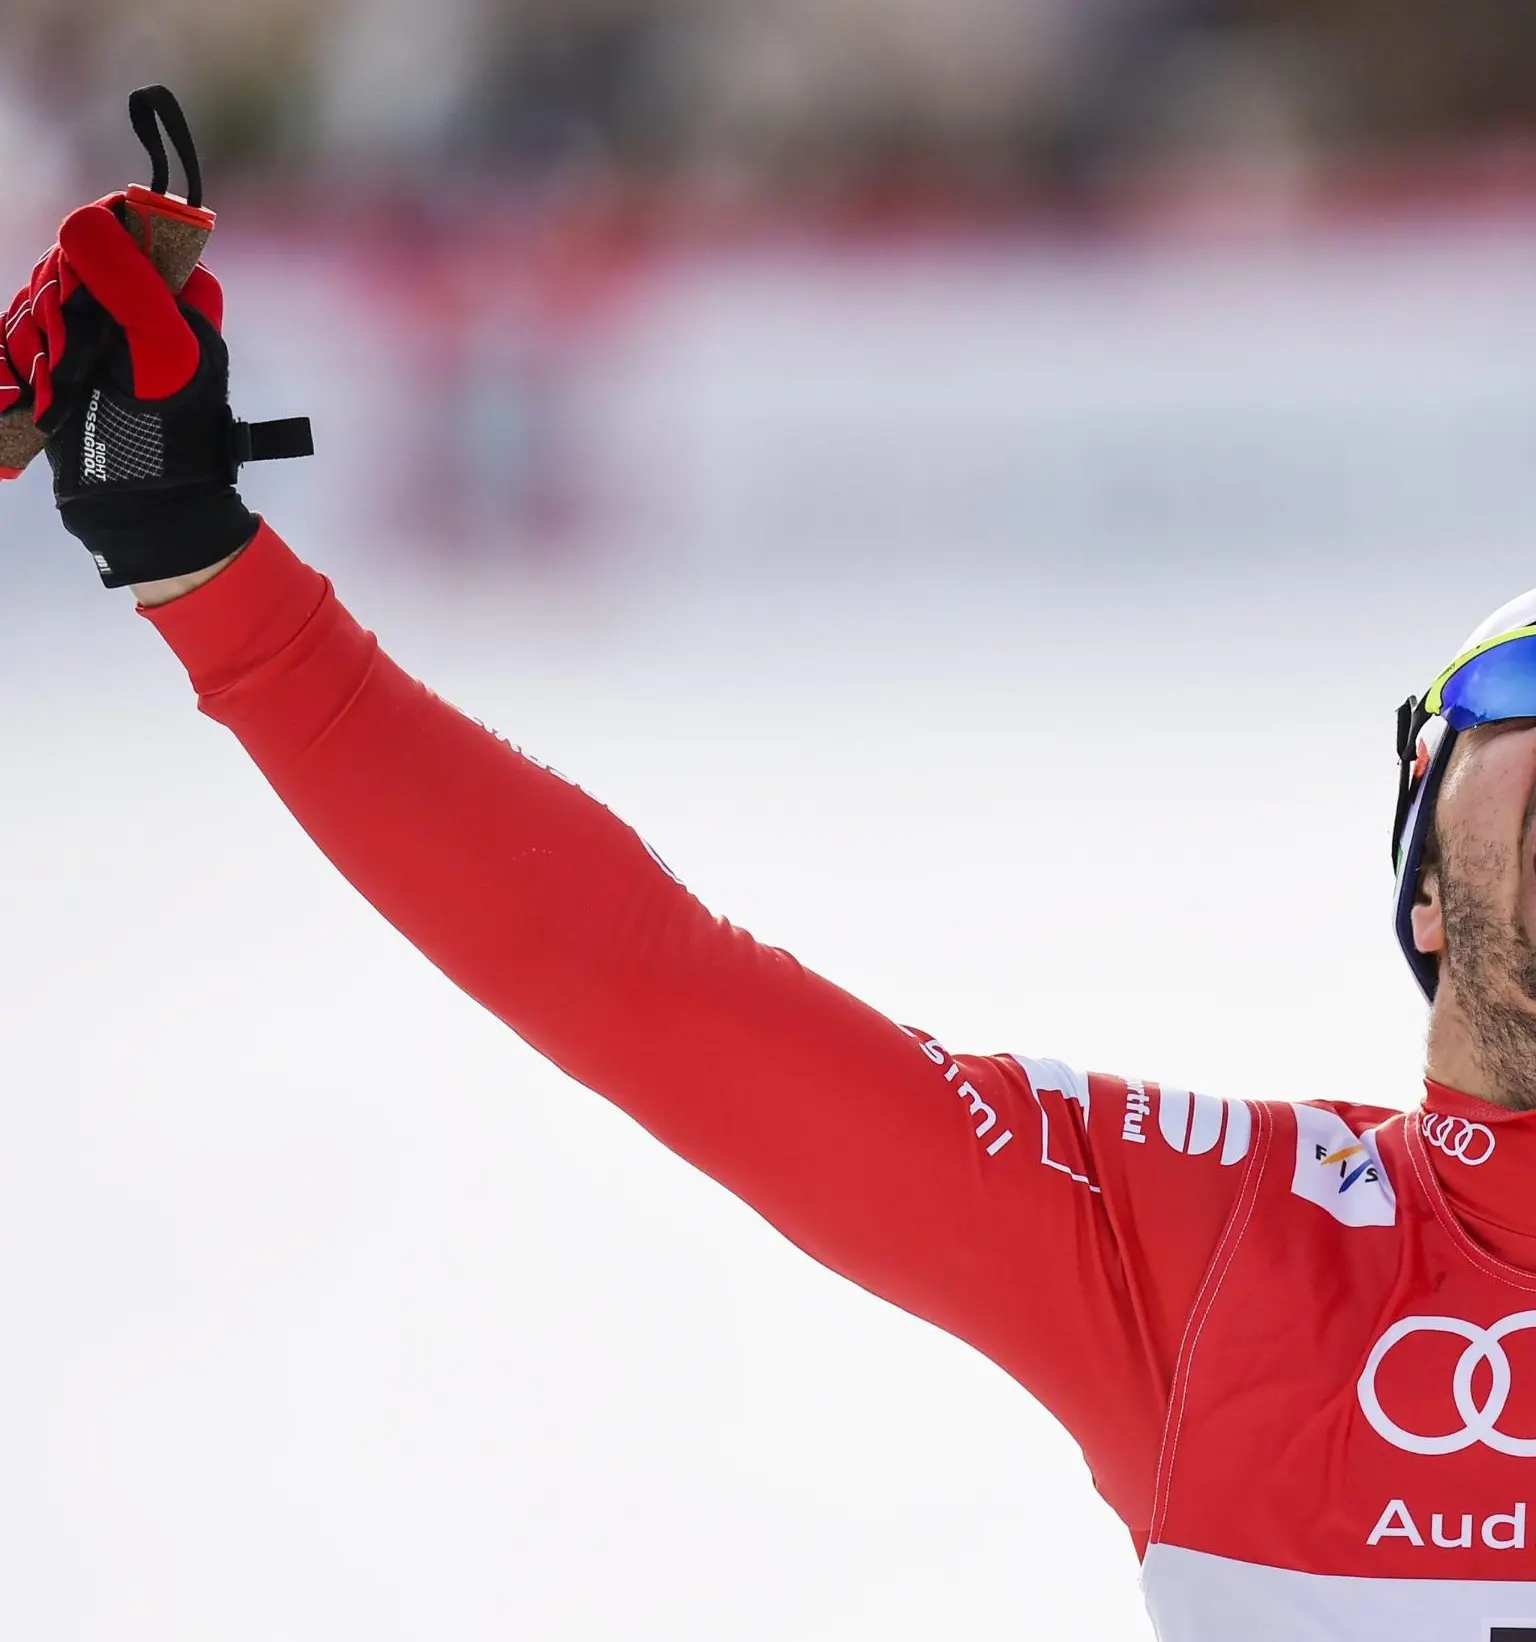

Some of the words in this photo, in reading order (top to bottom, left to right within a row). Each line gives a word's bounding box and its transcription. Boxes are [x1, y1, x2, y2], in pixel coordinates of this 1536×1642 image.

[83, 388, 101, 477] ROSSIGNOL
[95, 441, 107, 482] RIGHT
[1122, 1080, 1150, 1143] rtful
[1315, 1143, 1379, 1183] FIS
